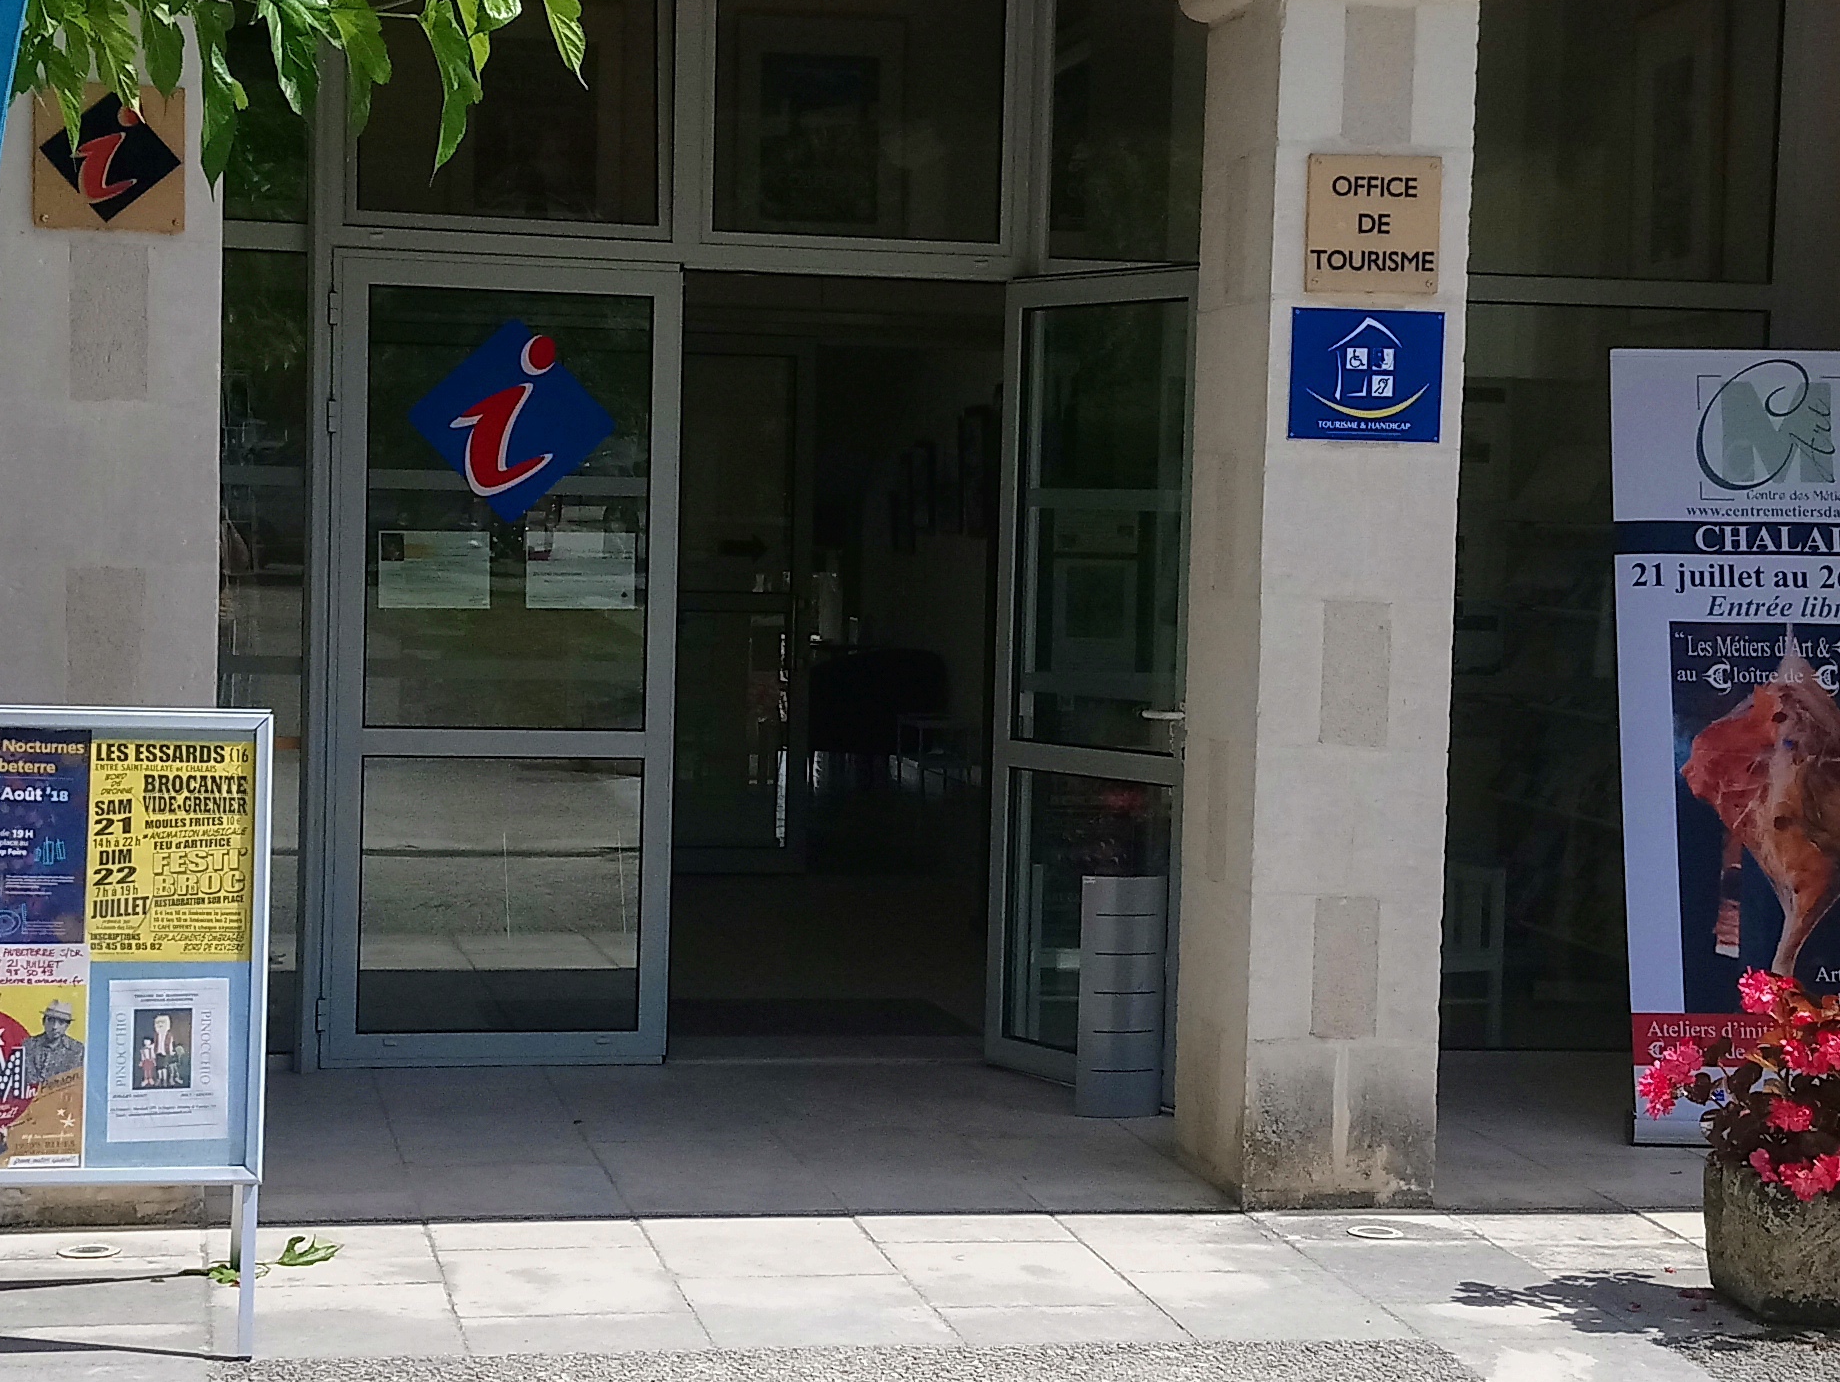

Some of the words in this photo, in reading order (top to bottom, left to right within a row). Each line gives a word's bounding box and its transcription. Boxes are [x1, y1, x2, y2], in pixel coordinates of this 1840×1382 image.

[1332, 176, 1417, 198] OFFICE
[1358, 213, 1390, 233] DE
[1311, 250, 1434, 272] TOURISME
[1318, 420, 1358, 428] TOURISME
[1368, 421, 1411, 429] HANDICAP
[1631, 563, 1662, 588] 21
[1675, 564, 1765, 593] juillet
[1774, 569, 1808, 590] au
[1707, 595, 1793, 618] Entrée
[1716, 635, 1771, 657] Métiers
[1774, 637, 1814, 657] d'Art
[1817, 637, 1830, 658] &
[1677, 668, 1696, 683] au
[1784, 669, 1803, 683] de
[3, 740, 84, 754] Nocturnes
[96, 743, 129, 762] LES
[135, 744, 225, 763] ESSARDS
[0, 786, 42, 801] Août
[143, 774, 248, 794] BROCANTE
[95, 799, 132, 816] SAM
[94, 817, 132, 836] 21
[145, 819, 187, 829] MOULES
[189, 817, 223, 827] FRITES
[154, 841, 173, 850] FEU
[99, 849, 132, 866] DIM
[93, 866, 137, 886] 22
[153, 871, 245, 897] BROC
[91, 896, 149, 919] JUILLET
[223, 895, 244, 903] PLACE
[90, 942, 103, 951] 05
[105, 942, 117, 951] 45
[150, 942, 162, 951] 82
[7, 959, 18, 967] 21
[20, 960, 64, 970] JUILLET
[1647, 1020, 1716, 1038] Ateliers
[1721, 1021, 1775, 1039] d'initi
[115, 1012, 126, 1087] PINOCCHIO
[200, 1010, 212, 1085] PINOCCHIO
